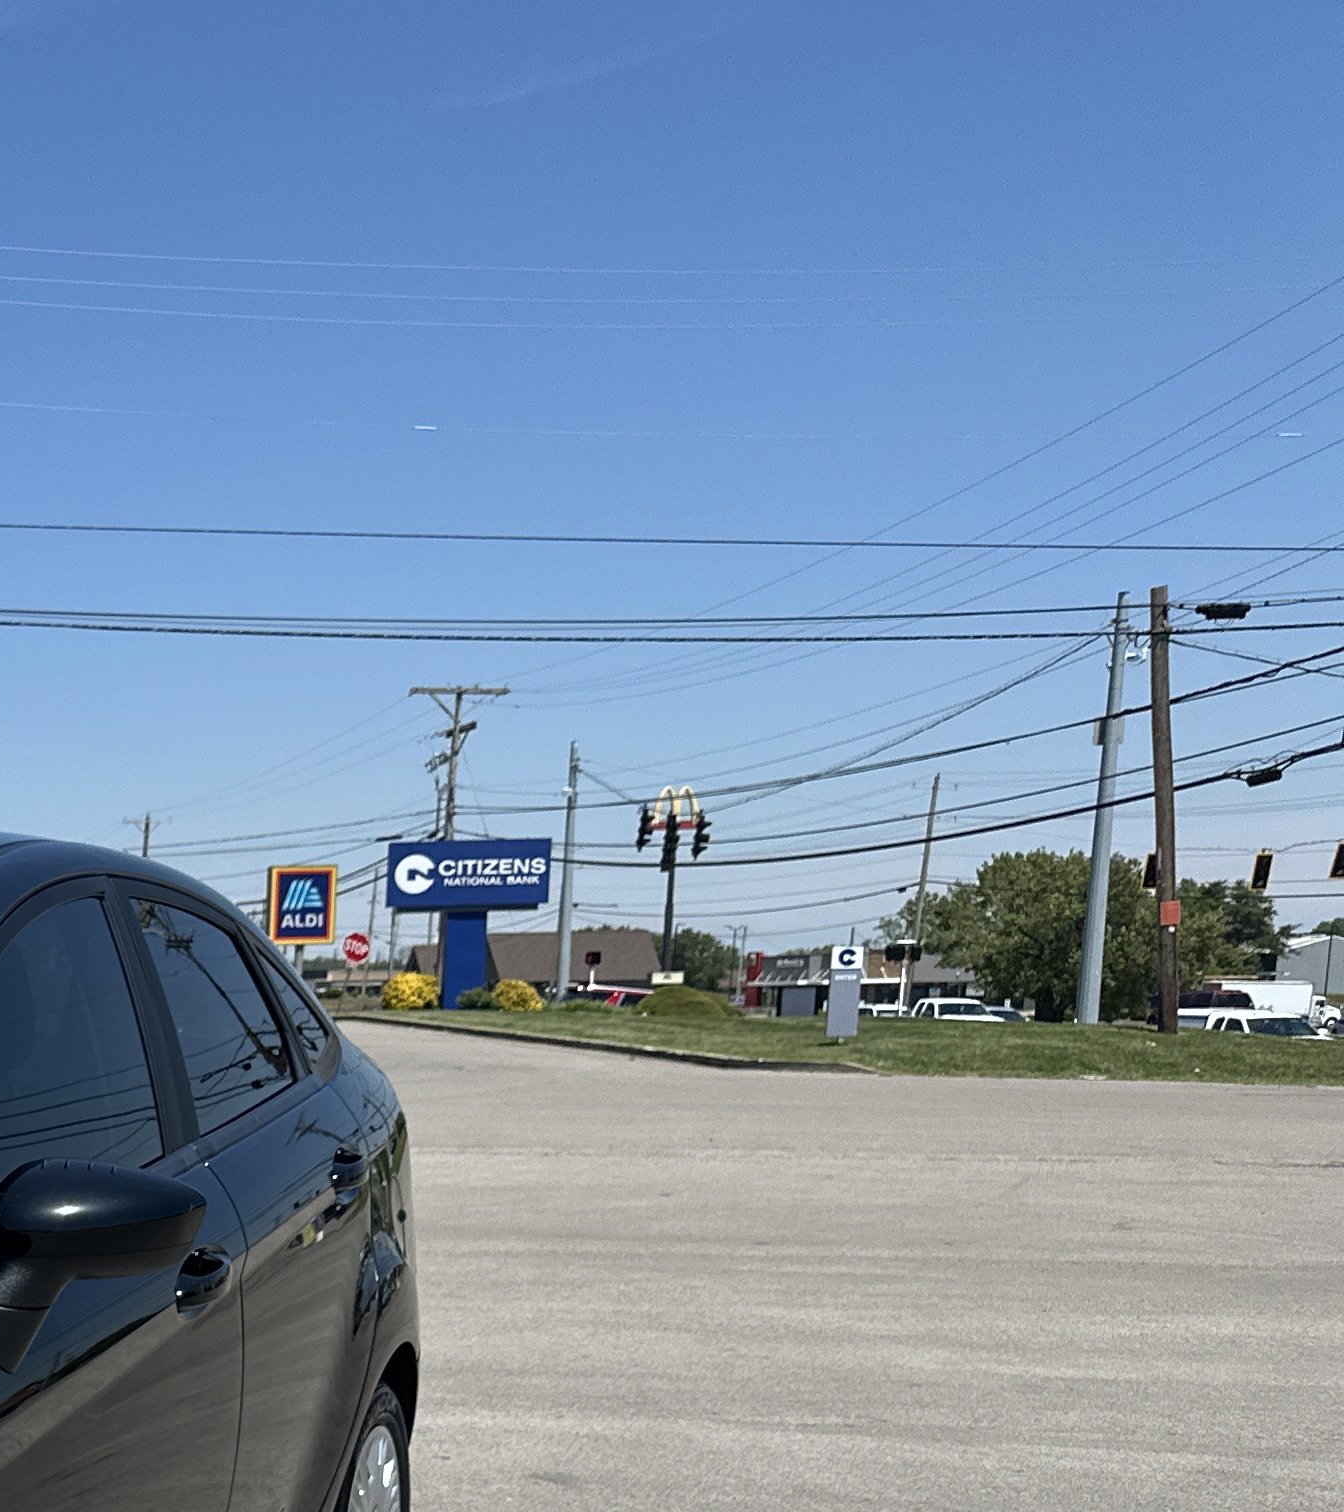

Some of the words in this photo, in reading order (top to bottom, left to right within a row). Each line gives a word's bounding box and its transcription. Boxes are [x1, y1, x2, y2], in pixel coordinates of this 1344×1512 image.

[438, 857, 546, 876] CITIZENS
[443, 876, 502, 887] NATIONAL
[506, 875, 540, 886] BANK
[281, 912, 324, 929] ALDI
[344, 938, 369, 955] STOP
